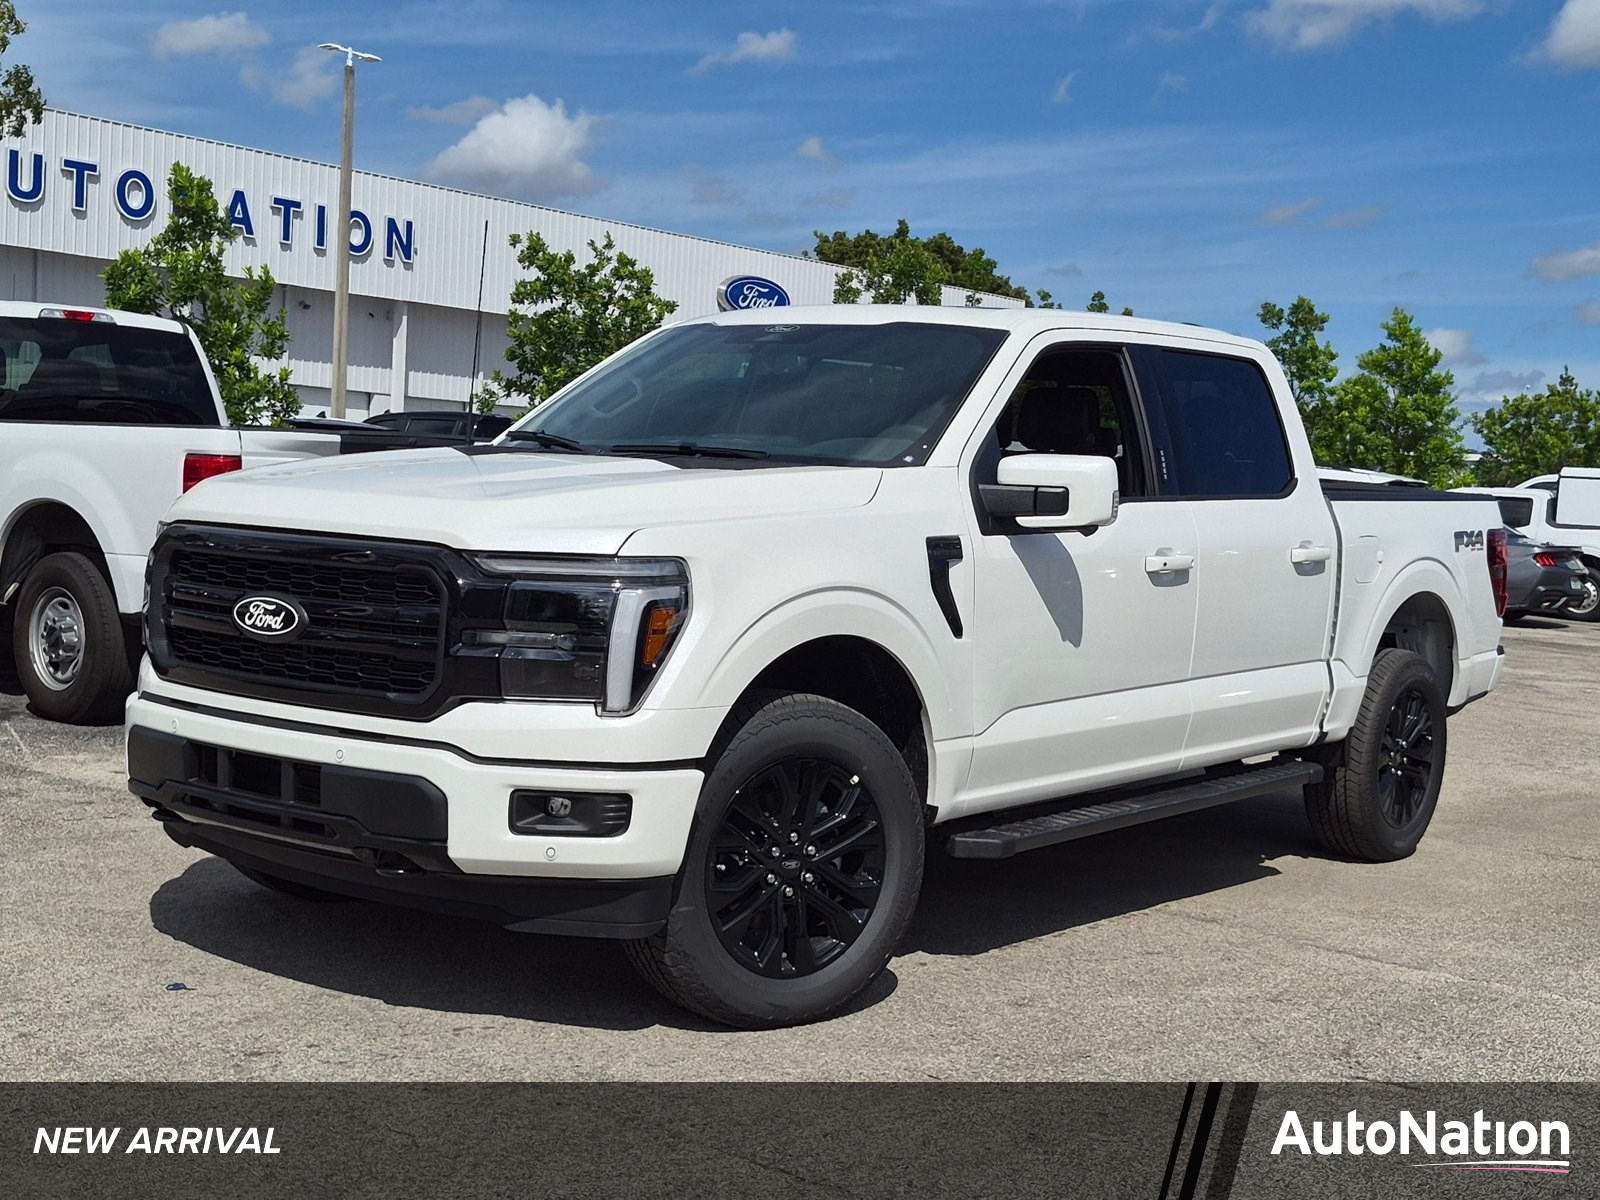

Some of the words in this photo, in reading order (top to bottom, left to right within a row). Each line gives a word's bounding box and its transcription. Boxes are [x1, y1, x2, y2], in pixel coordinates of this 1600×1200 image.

[7, 147, 415, 263] UTOATION
[738, 284, 779, 310] Ford
[1453, 530, 1484, 552] FX4
[244, 601, 286, 630] Ford
